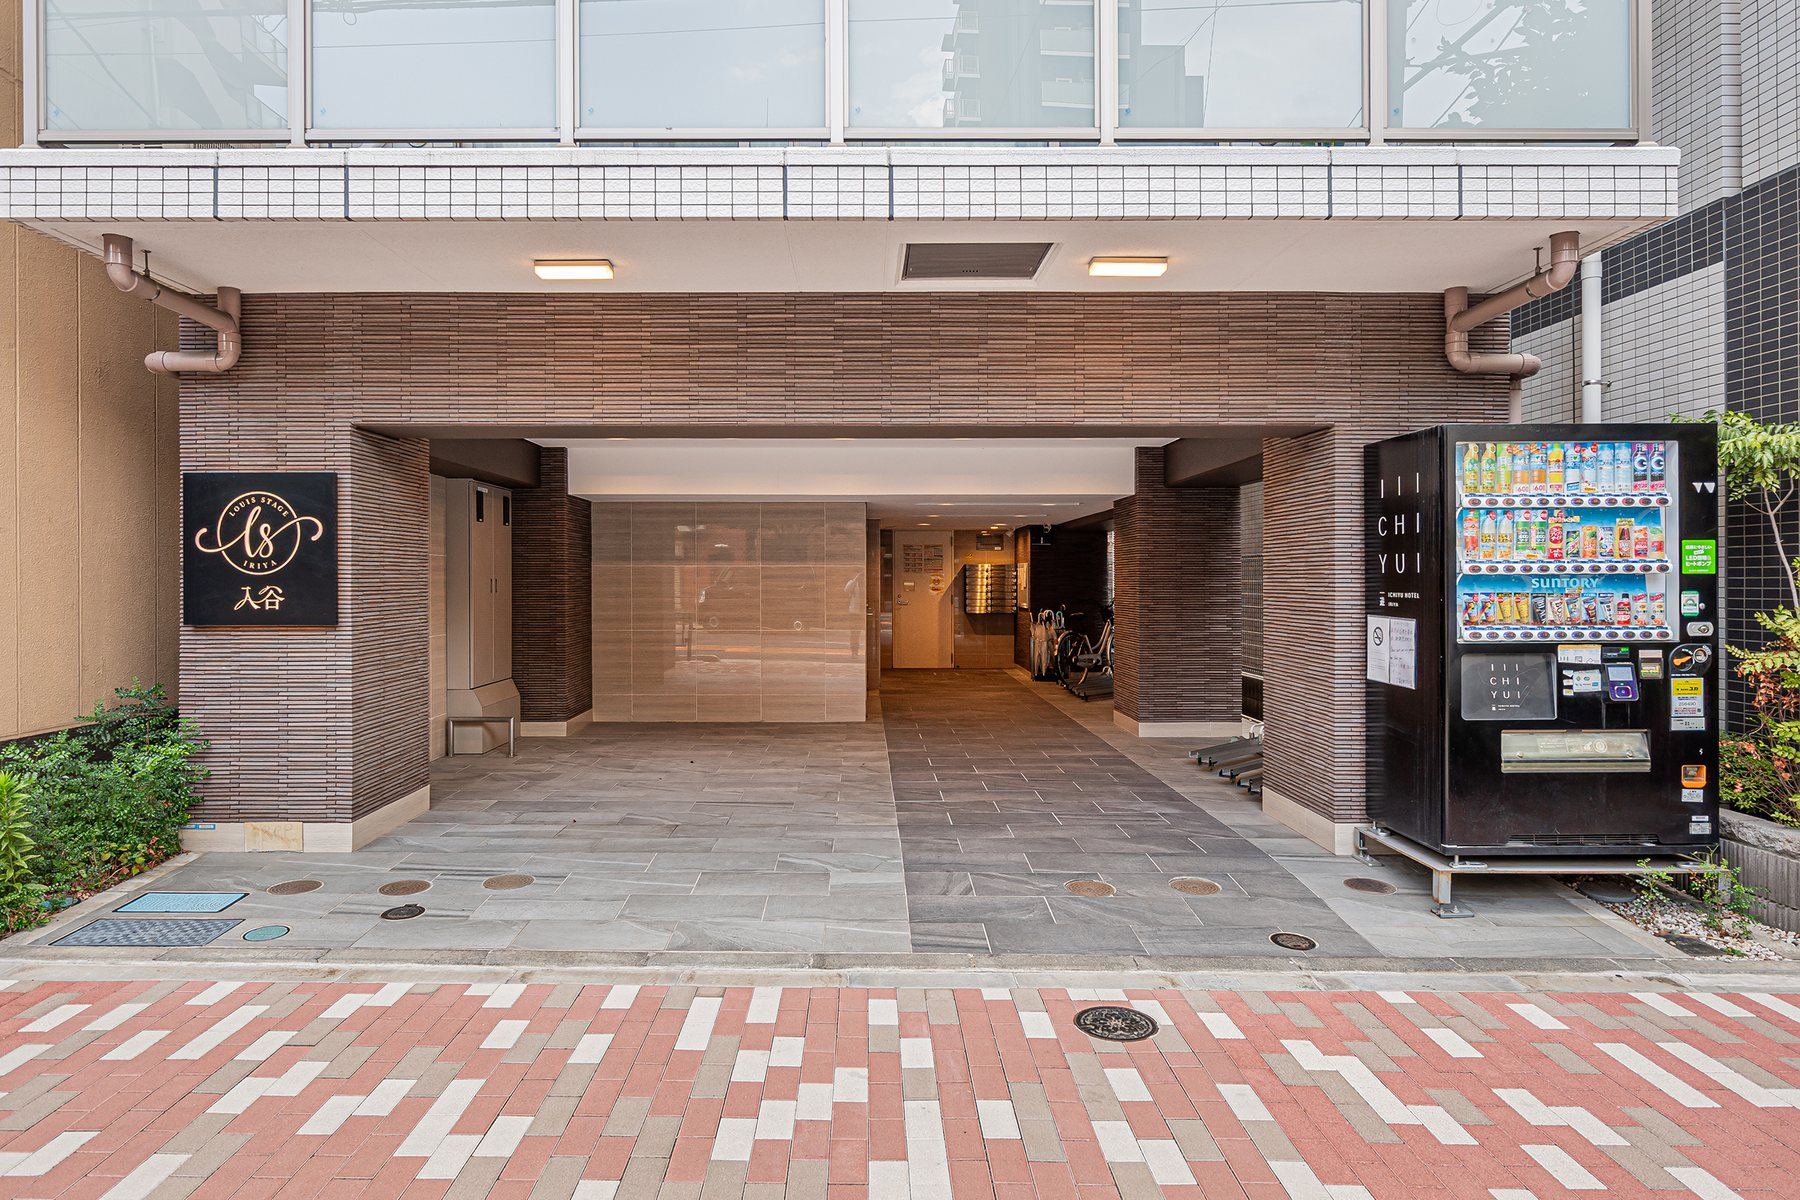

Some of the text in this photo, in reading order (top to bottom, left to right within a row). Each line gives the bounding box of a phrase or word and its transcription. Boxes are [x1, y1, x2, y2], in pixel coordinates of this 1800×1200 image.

[228, 496, 290, 517] LOUIS STAGE
[243, 560, 277, 570] IRIYA
[234, 585, 286, 611] 入谷
